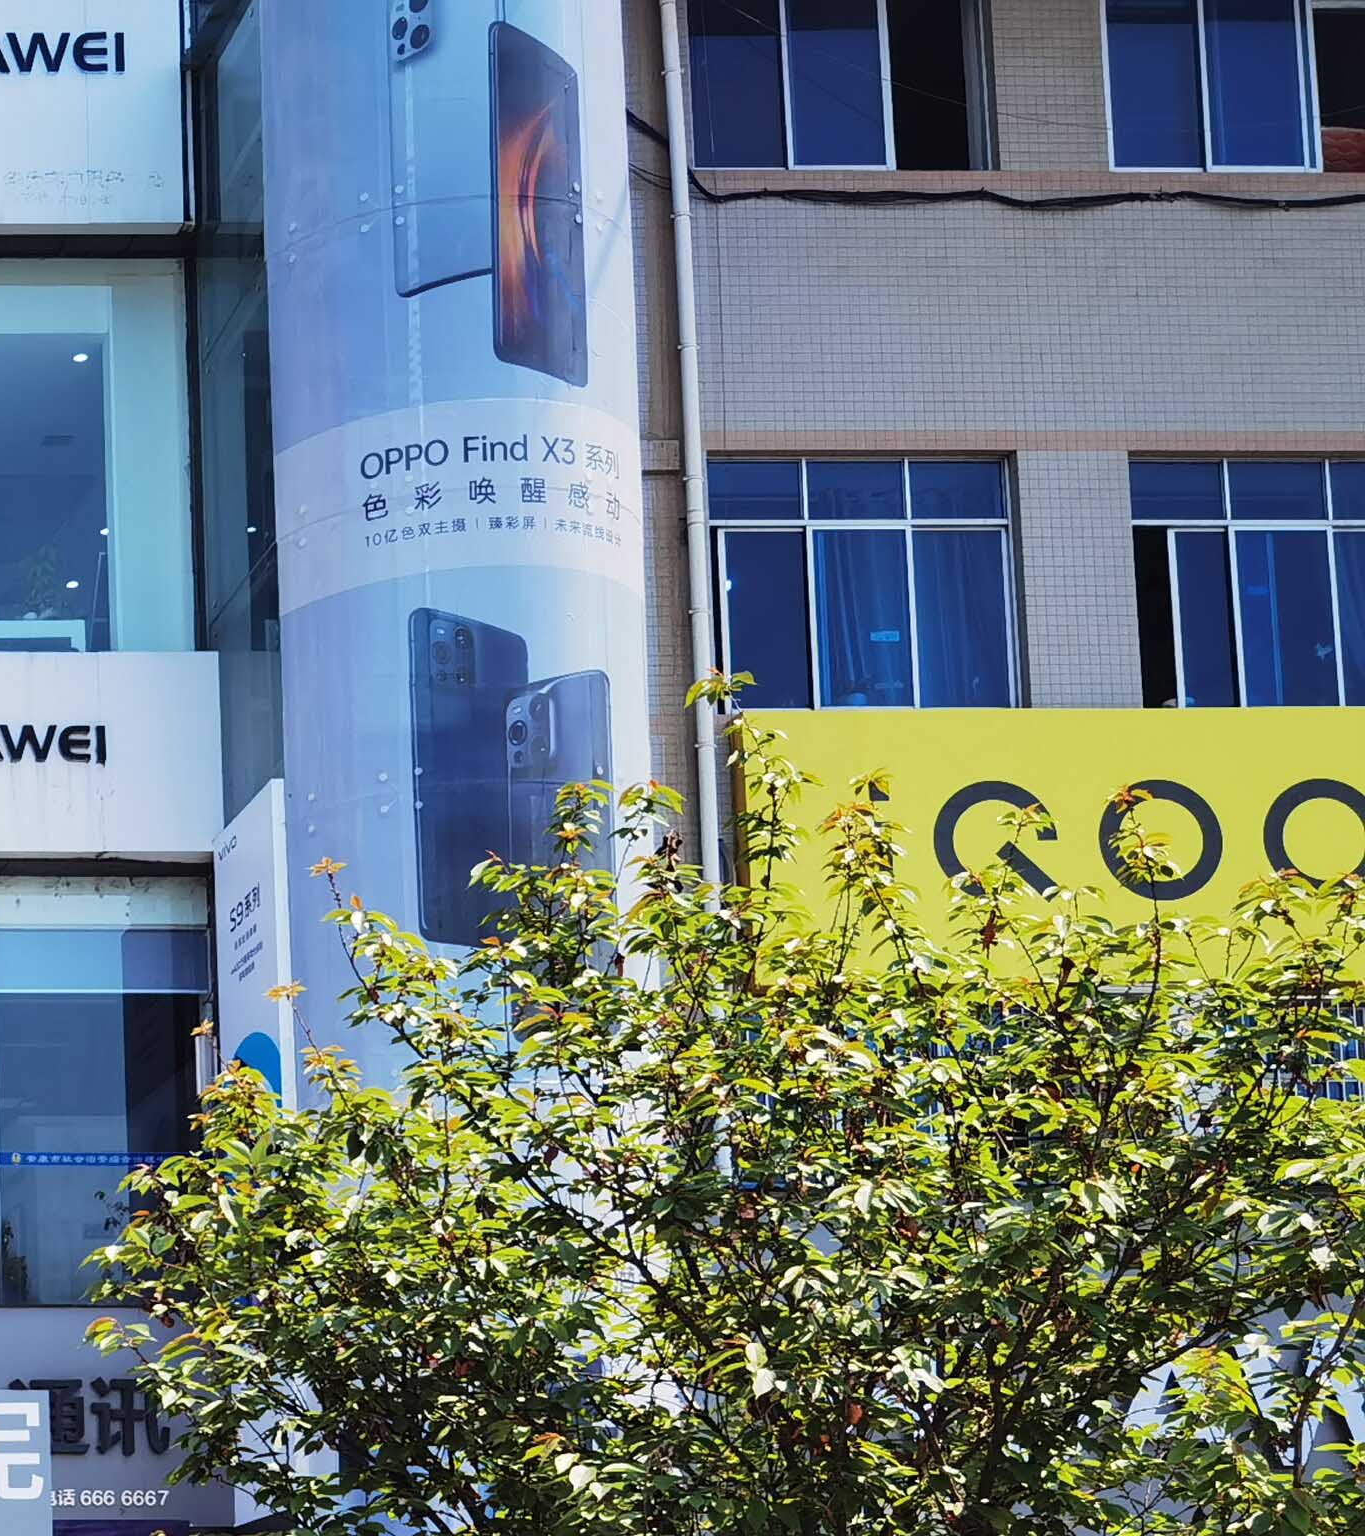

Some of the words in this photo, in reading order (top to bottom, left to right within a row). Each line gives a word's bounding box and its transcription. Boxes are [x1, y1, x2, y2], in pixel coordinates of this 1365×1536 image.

[360, 439, 449, 480] OPPO
[463, 434, 528, 463] Find
[541, 436, 576, 465] X3
[584, 442, 620, 480] 系列
[362, 476, 621, 521] 色彩唤醒感动
[218, 835, 238, 861] vivo
[229, 881, 261, 933] S9系列
[80, 1490, 115, 1506] 666
[121, 1490, 169, 1506] 6667
